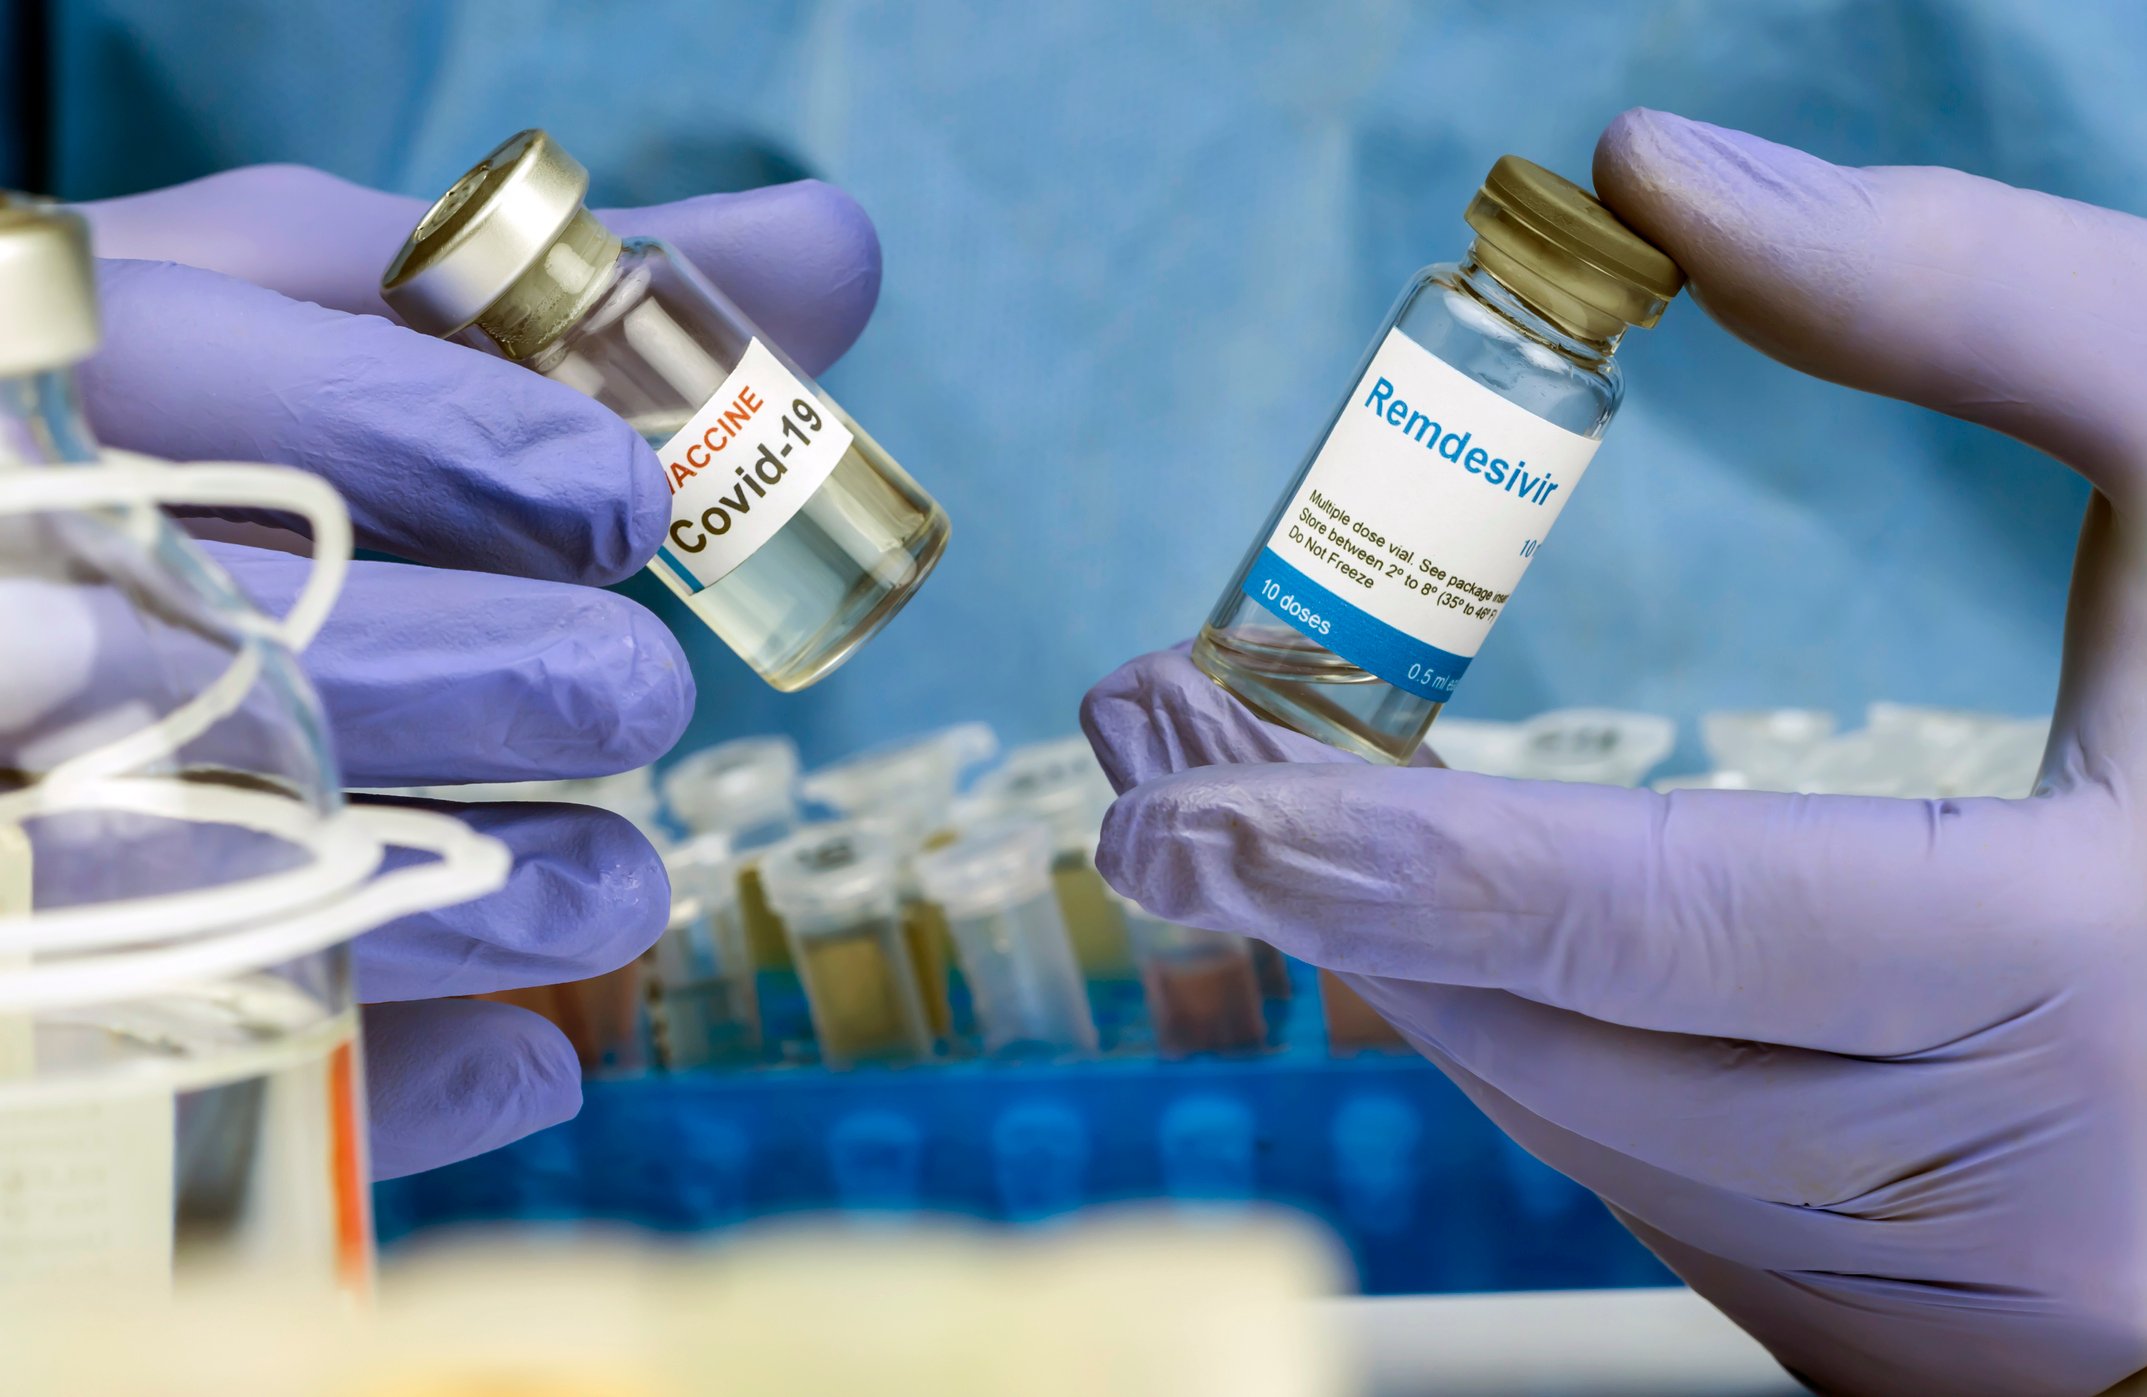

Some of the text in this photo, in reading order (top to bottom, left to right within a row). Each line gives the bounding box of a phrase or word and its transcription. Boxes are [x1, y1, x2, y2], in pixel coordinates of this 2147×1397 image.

[669, 398, 823, 554] Covid-19
[1364, 376, 1559, 507] Remdesivir
[1288, 525, 1375, 589] Do Not Freeze
[1299, 507, 1327, 535] Store
[1328, 528, 1384, 571] between
[1404, 574, 1419, 590] to
[1463, 602, 1475, 616] to
[1309, 489, 1351, 526] Multiple
[1352, 522, 1386, 548] dose
[1388, 543, 1415, 566] vial.
[1419, 558, 1447, 581] See
[1446, 576, 1493, 602] package
[1261, 578, 1331, 635] 10 doses
[1407, 663, 1434, 685] 0.5
[1431, 675, 1450, 690] ml
